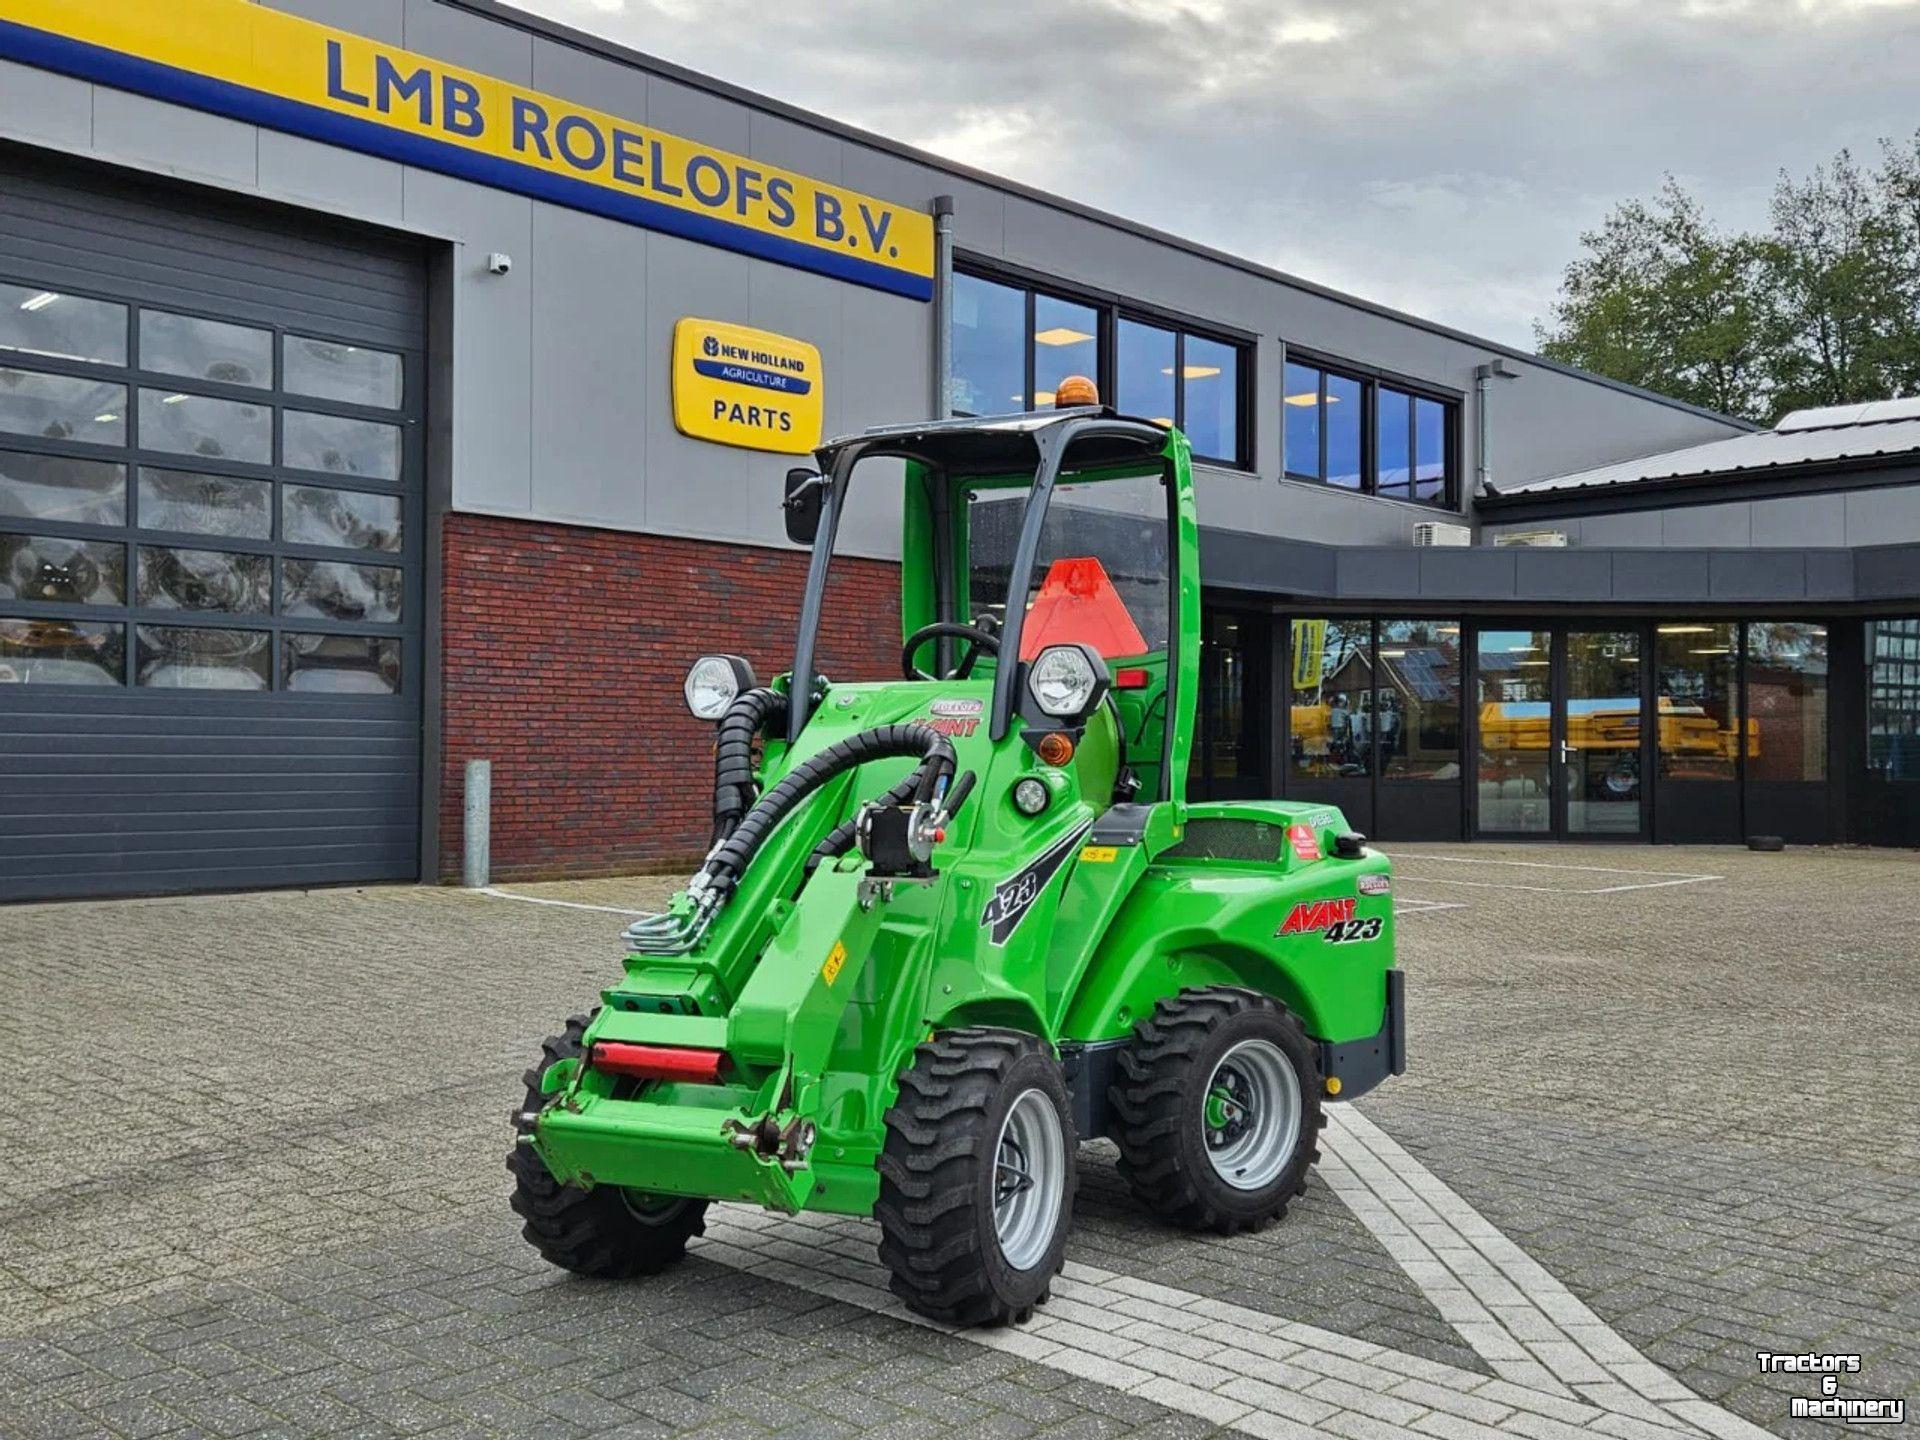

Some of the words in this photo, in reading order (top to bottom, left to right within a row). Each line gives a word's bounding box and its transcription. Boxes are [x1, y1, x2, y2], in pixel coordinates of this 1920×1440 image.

[327, 40, 484, 137] LMB
[512, 96, 797, 228] ROELOFS
[816, 191, 899, 258] B.V.
[722, 345, 749, 361] NEW
[751, 351, 804, 372] HOLLAND
[722, 367, 787, 388] AGRICULTURE
[714, 400, 792, 432] PARTS
[980, 872, 1036, 928] 423
[1274, 898, 1357, 937] AVANT
[1324, 917, 1383, 944] 423
